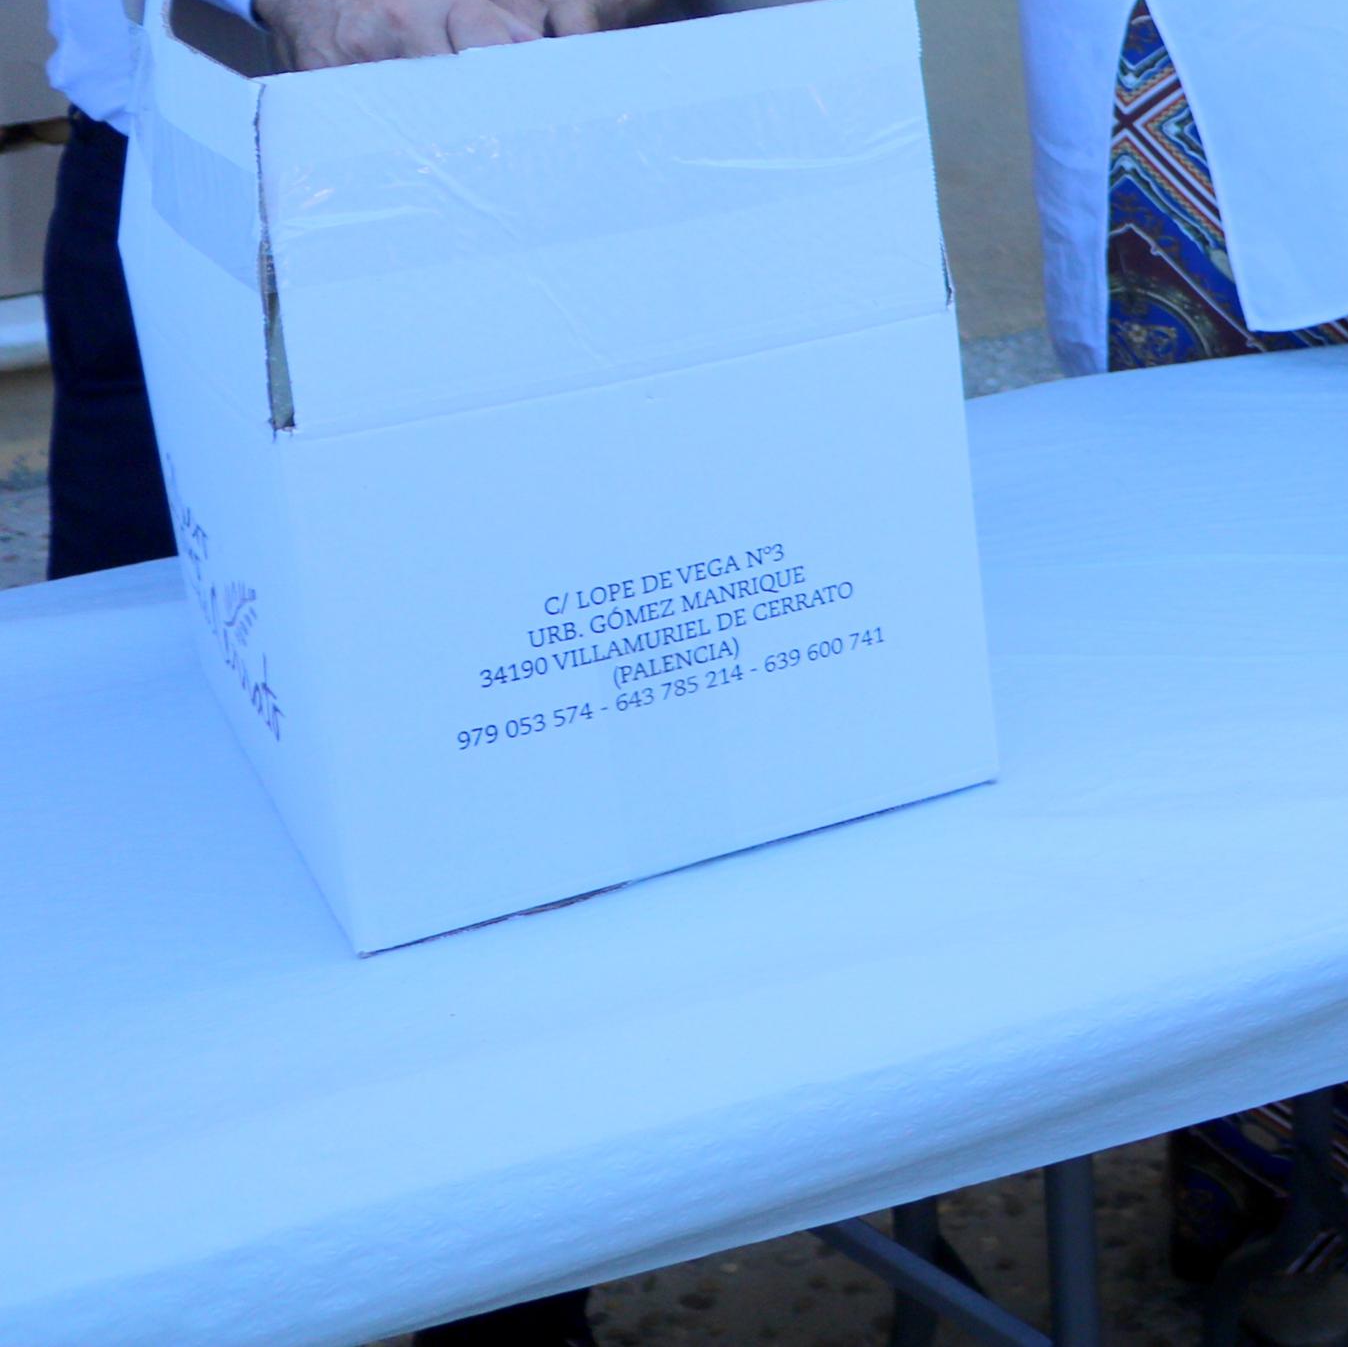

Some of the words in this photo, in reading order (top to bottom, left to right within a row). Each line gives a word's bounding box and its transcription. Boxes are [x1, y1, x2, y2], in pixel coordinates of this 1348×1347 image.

[527, 623, 583, 648] URB.
[590, 597, 675, 634] GÓMEZ
[680, 565, 806, 613] MANRIQUE
[543, 591, 570, 616] C/
[576, 580, 636, 610] LOPE
[641, 571, 674, 595] DE
[678, 557, 741, 587] VEGA
[479, 657, 549, 689] 34190
[553, 618, 711, 671] VILLAMURIEL
[717, 608, 747, 632] DE
[752, 581, 854, 622] CERRATO
[613, 635, 741, 690] (PALENCIA)
[457, 725, 499, 751] 979
[505, 714, 547, 739] 053
[553, 702, 593, 728] 574
[615, 687, 655, 713] 643
[661, 676, 699, 701] 785
[706, 663, 744, 689] 214
[764, 647, 801, 674] 639
[806, 636, 844, 662] 600
[849, 626, 885, 651] 741
